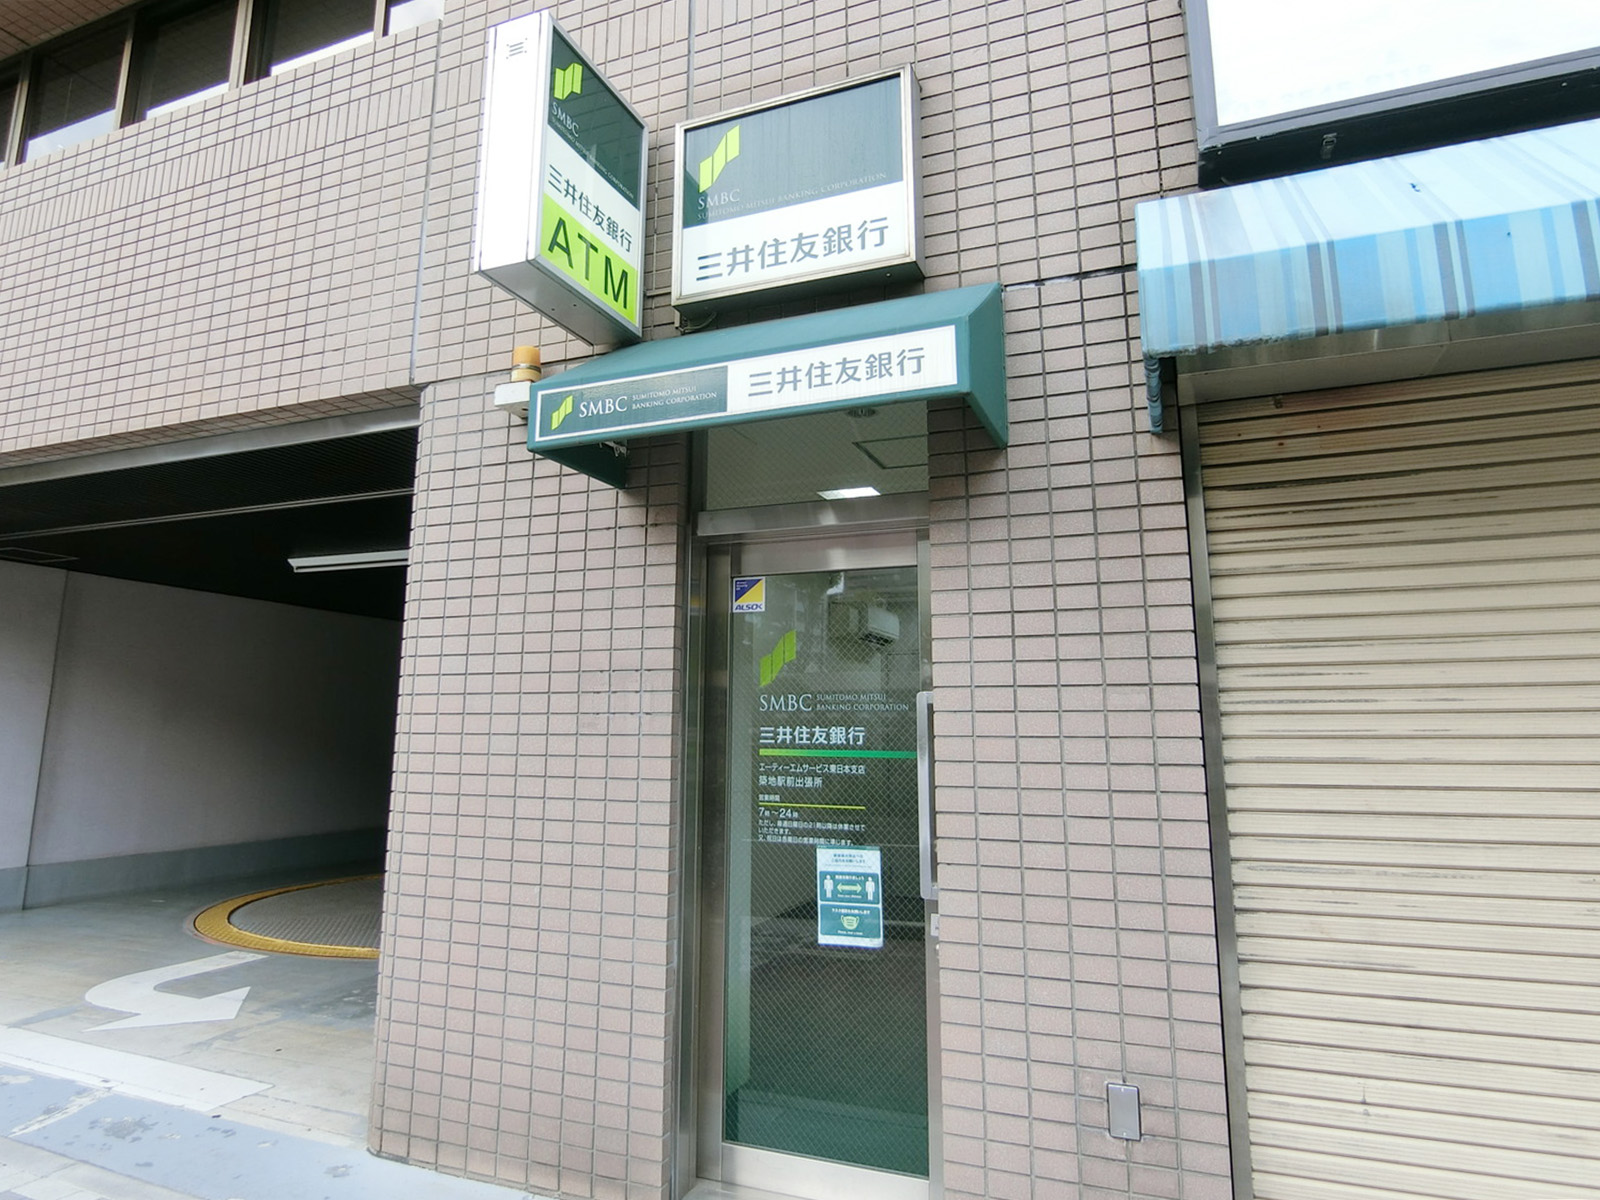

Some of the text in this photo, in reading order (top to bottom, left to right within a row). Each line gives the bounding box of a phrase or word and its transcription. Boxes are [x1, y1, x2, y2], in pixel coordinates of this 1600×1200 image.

[552, 102, 579, 137] SMBC
[697, 205, 744, 220] SUMITOMO
[778, 189, 818, 204] BANKING
[820, 172, 887, 193] CORPORATION
[698, 189, 740, 210] SMBC
[548, 164, 632, 252] 三井住友銀行
[696, 216, 889, 281] 三井住友銀行
[548, 217, 628, 310] ATM
[748, 347, 925, 397] 三井住友銀行
[579, 385, 697, 418] SMBC SUMITOMO MITSUI
[632, 391, 718, 410] BANKING CORPORATION
[735, 603, 763, 611] ALSOK
[760, 694, 812, 711] SMBC
[816, 693, 857, 701] SUMITOMO
[816, 703, 909, 711] BANKING CORPORATION
[759, 726, 865, 745] 三井住友銀行
[759, 763, 866, 774] エーティーエムサービス東日本支店
[759, 776, 822, 788] 築地駅前出張所
